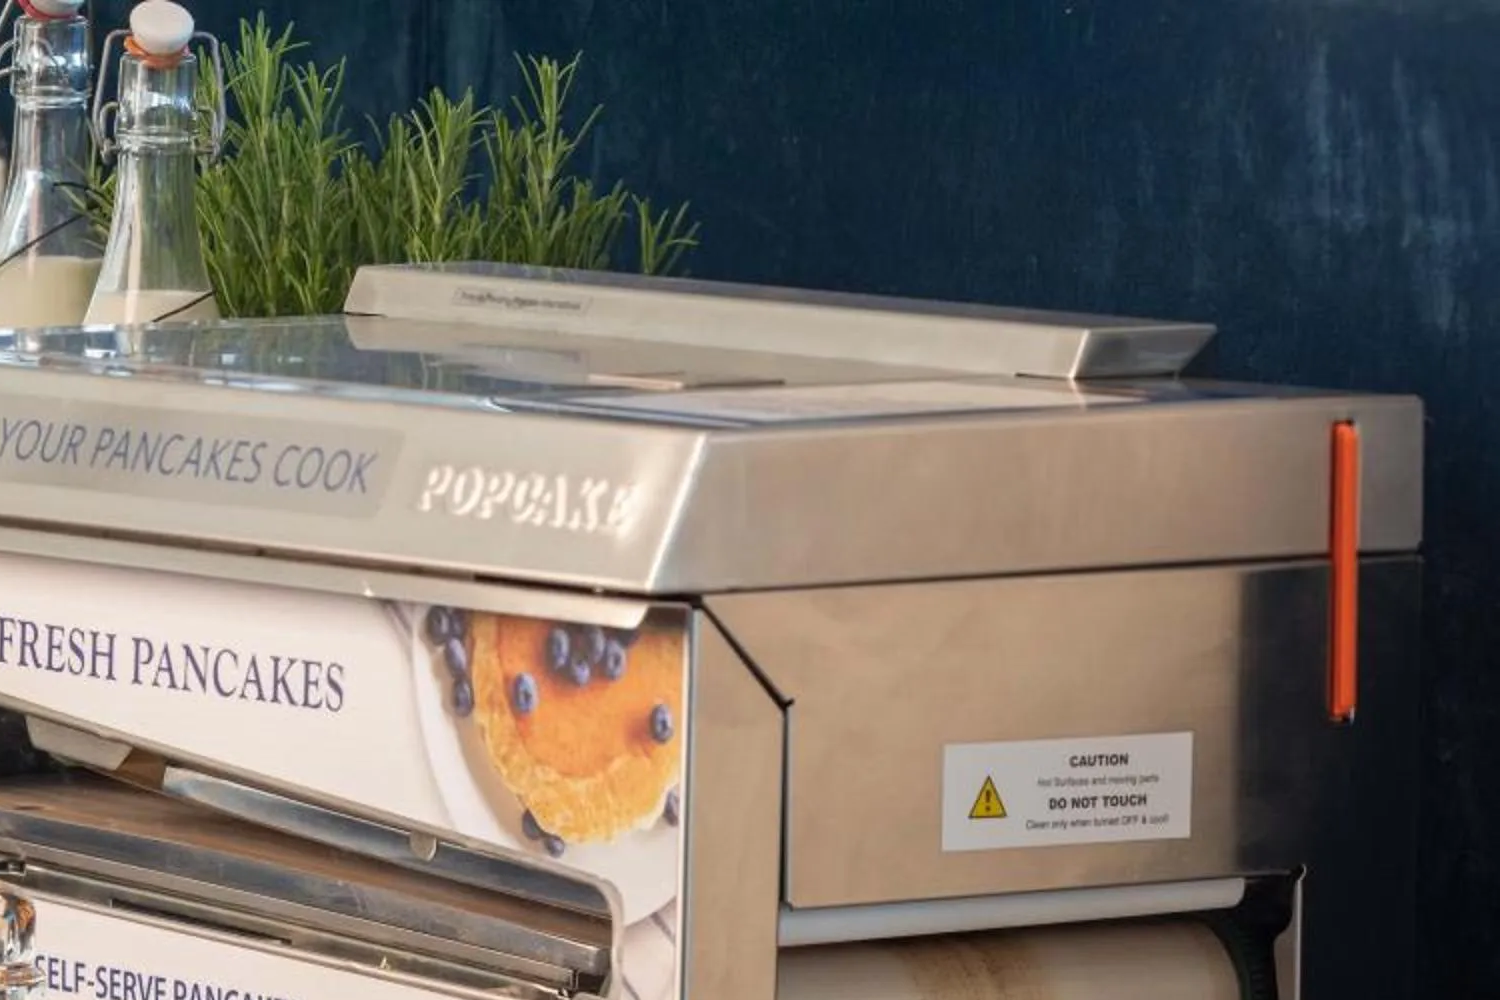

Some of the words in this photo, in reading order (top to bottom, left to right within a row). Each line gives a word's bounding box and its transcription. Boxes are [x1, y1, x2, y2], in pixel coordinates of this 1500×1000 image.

[0, 417, 87, 464] YOUR
[90, 428, 268, 485] PANCAKES
[274, 446, 379, 494] COOK
[130, 634, 345, 713] PANCAKES
[1069, 753, 1129, 768] CAUTION
[1049, 797, 1068, 810] DO
[1071, 796, 1098, 809] NOT
[1102, 794, 1147, 807] TOUCH
